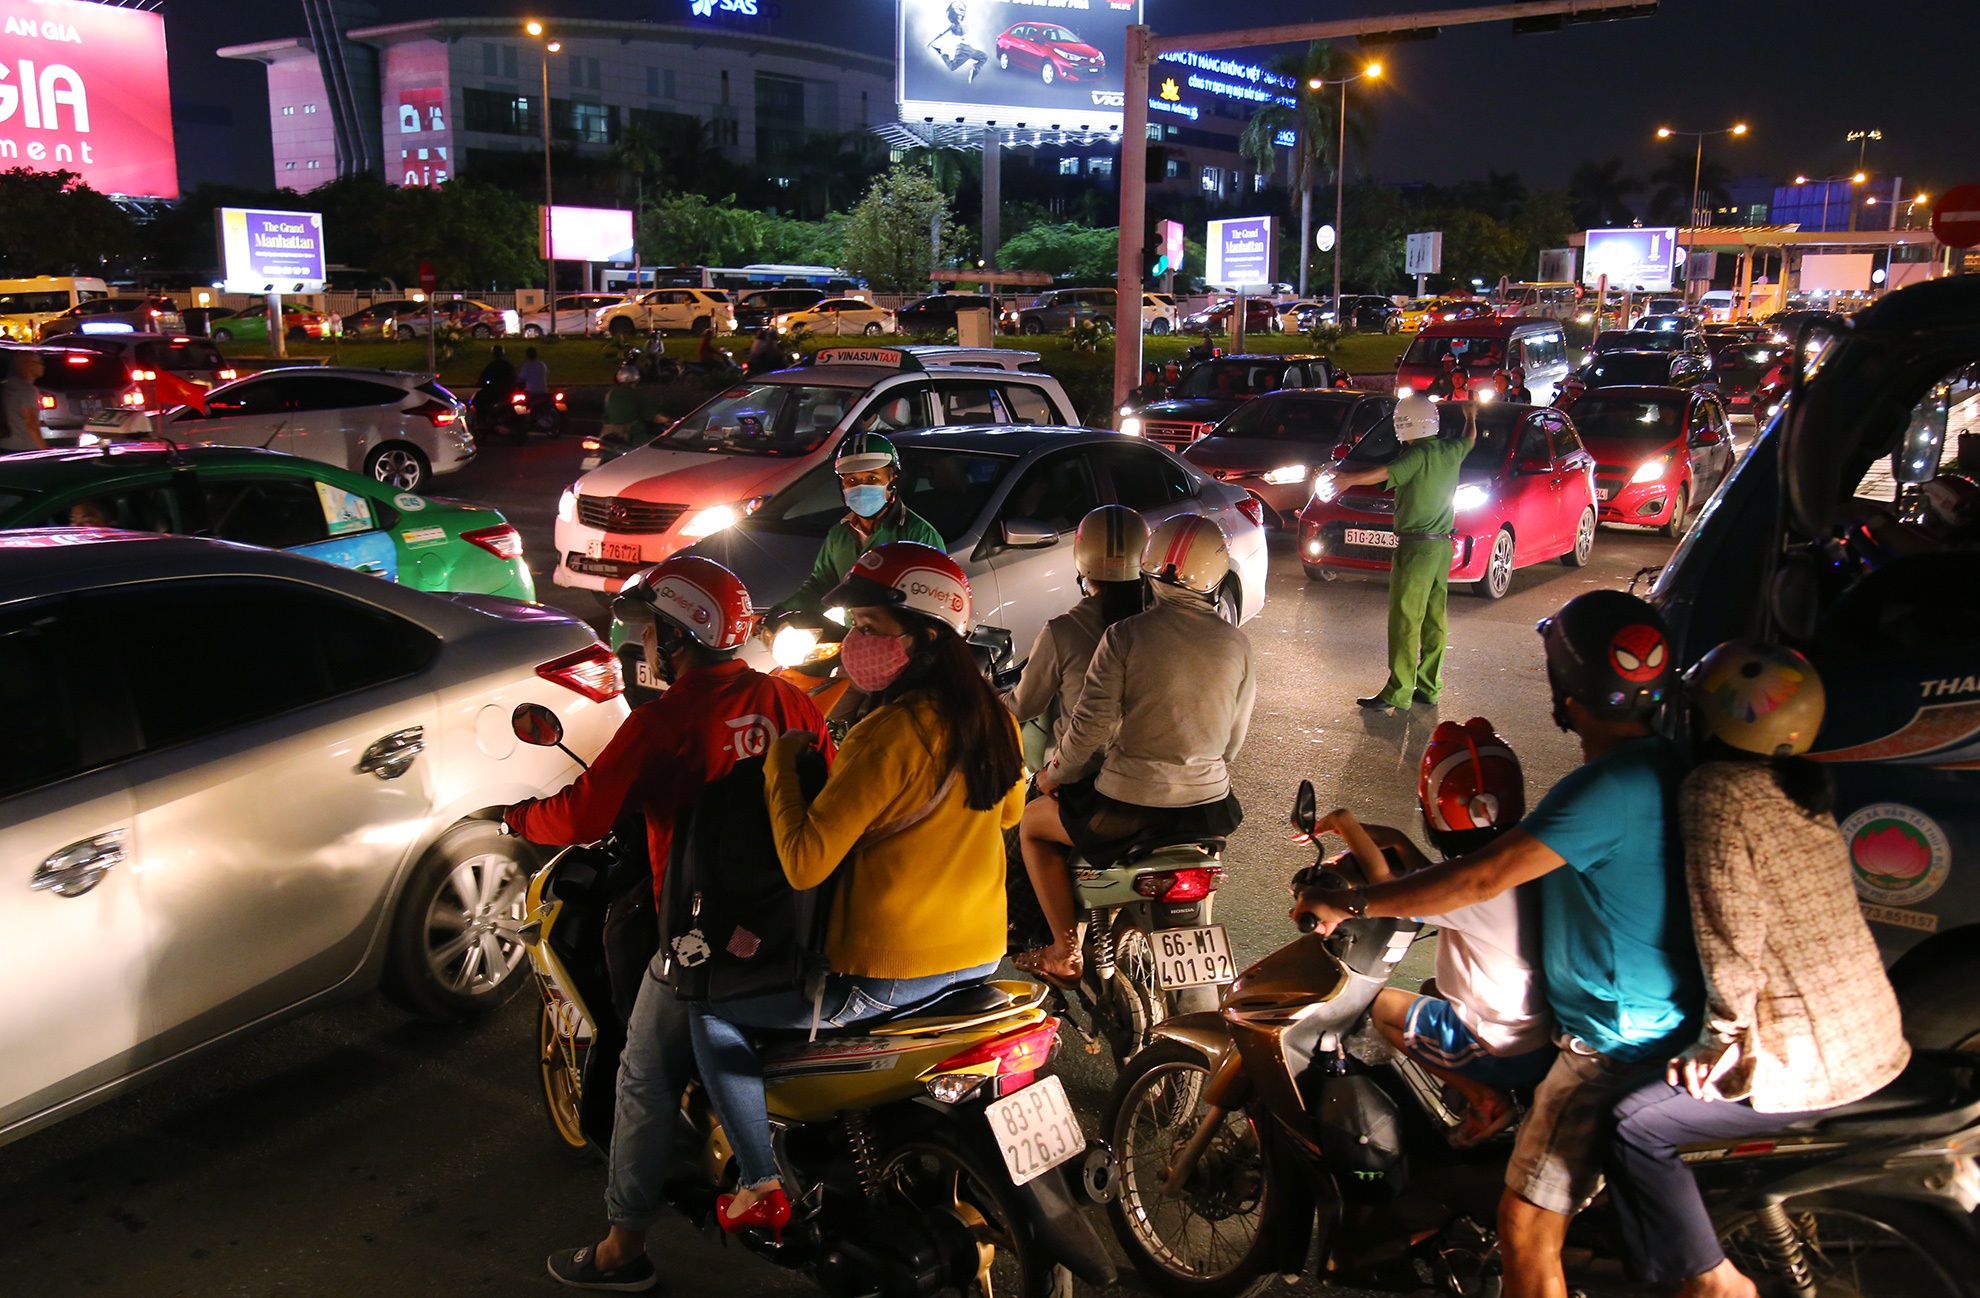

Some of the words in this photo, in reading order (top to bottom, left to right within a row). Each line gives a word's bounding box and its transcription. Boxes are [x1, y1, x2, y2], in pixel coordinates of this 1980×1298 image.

[5, 16, 38, 38] AN
[41, 21, 82, 44] GIA
[1188, 53, 1198, 67] TY
[1198, 54, 1220, 74] HÀNG
[1092, 94, 1125, 107] VIO
[263, 221, 279, 233] The
[280, 222, 304, 234] Grand
[1232, 229, 1241, 239] The
[1241, 228, 1258, 239] Grand
[255, 233, 315, 250] Manhattan
[1225, 241, 1264, 254] Manhattan
[1920, 675, 1980, 697] THA
[1161, 955, 1231, 985] 401.92
[1008, 1117, 1080, 1175] 226.31
